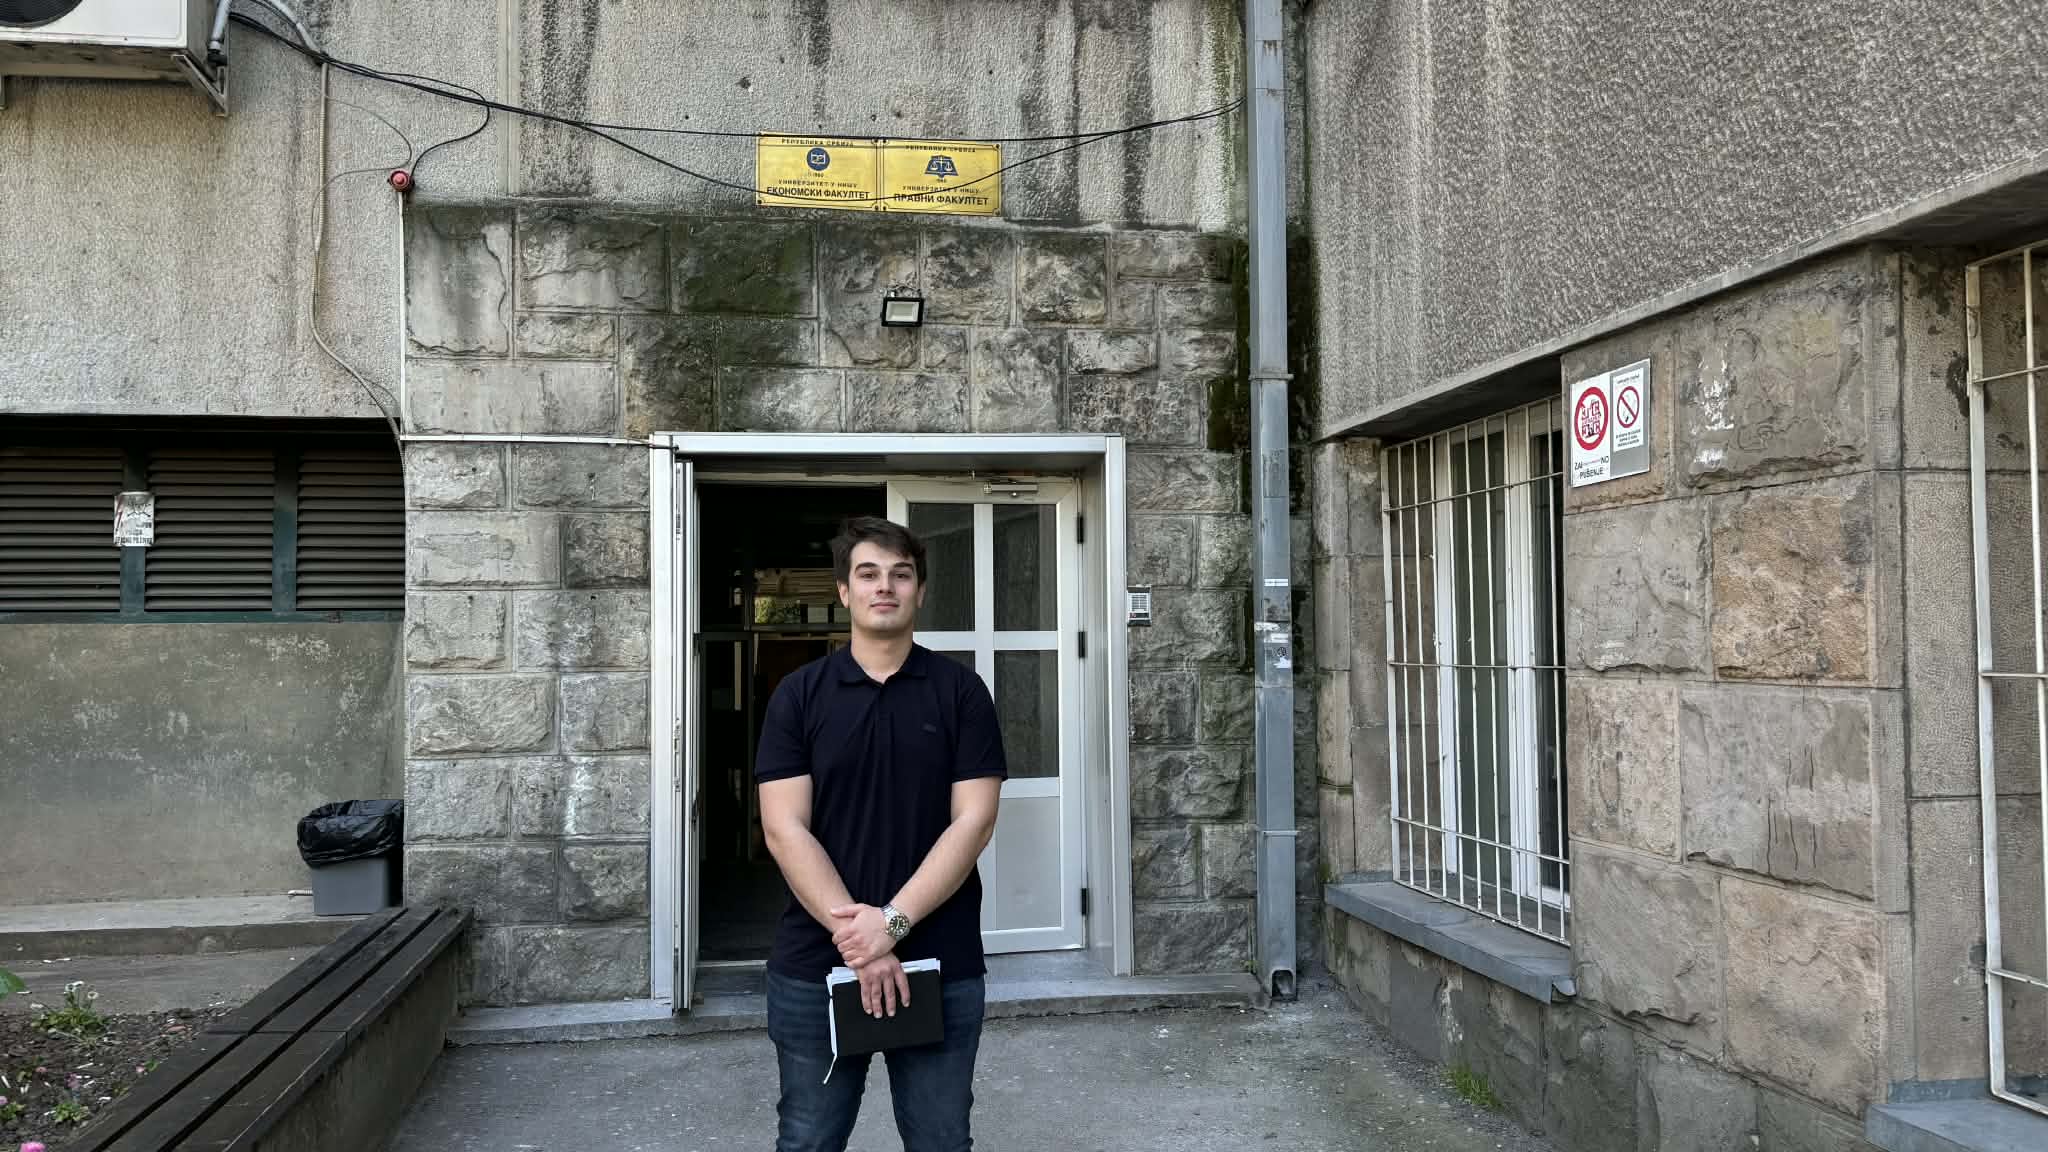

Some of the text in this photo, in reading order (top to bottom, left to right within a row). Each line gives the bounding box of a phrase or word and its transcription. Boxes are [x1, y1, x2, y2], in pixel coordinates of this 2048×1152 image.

[767, 186, 871, 199] ЕКОНОМСКИ ФАКУЛТЕТ
[894, 193, 989, 206] ПРАВНИ ФАКУЛТЕТ
